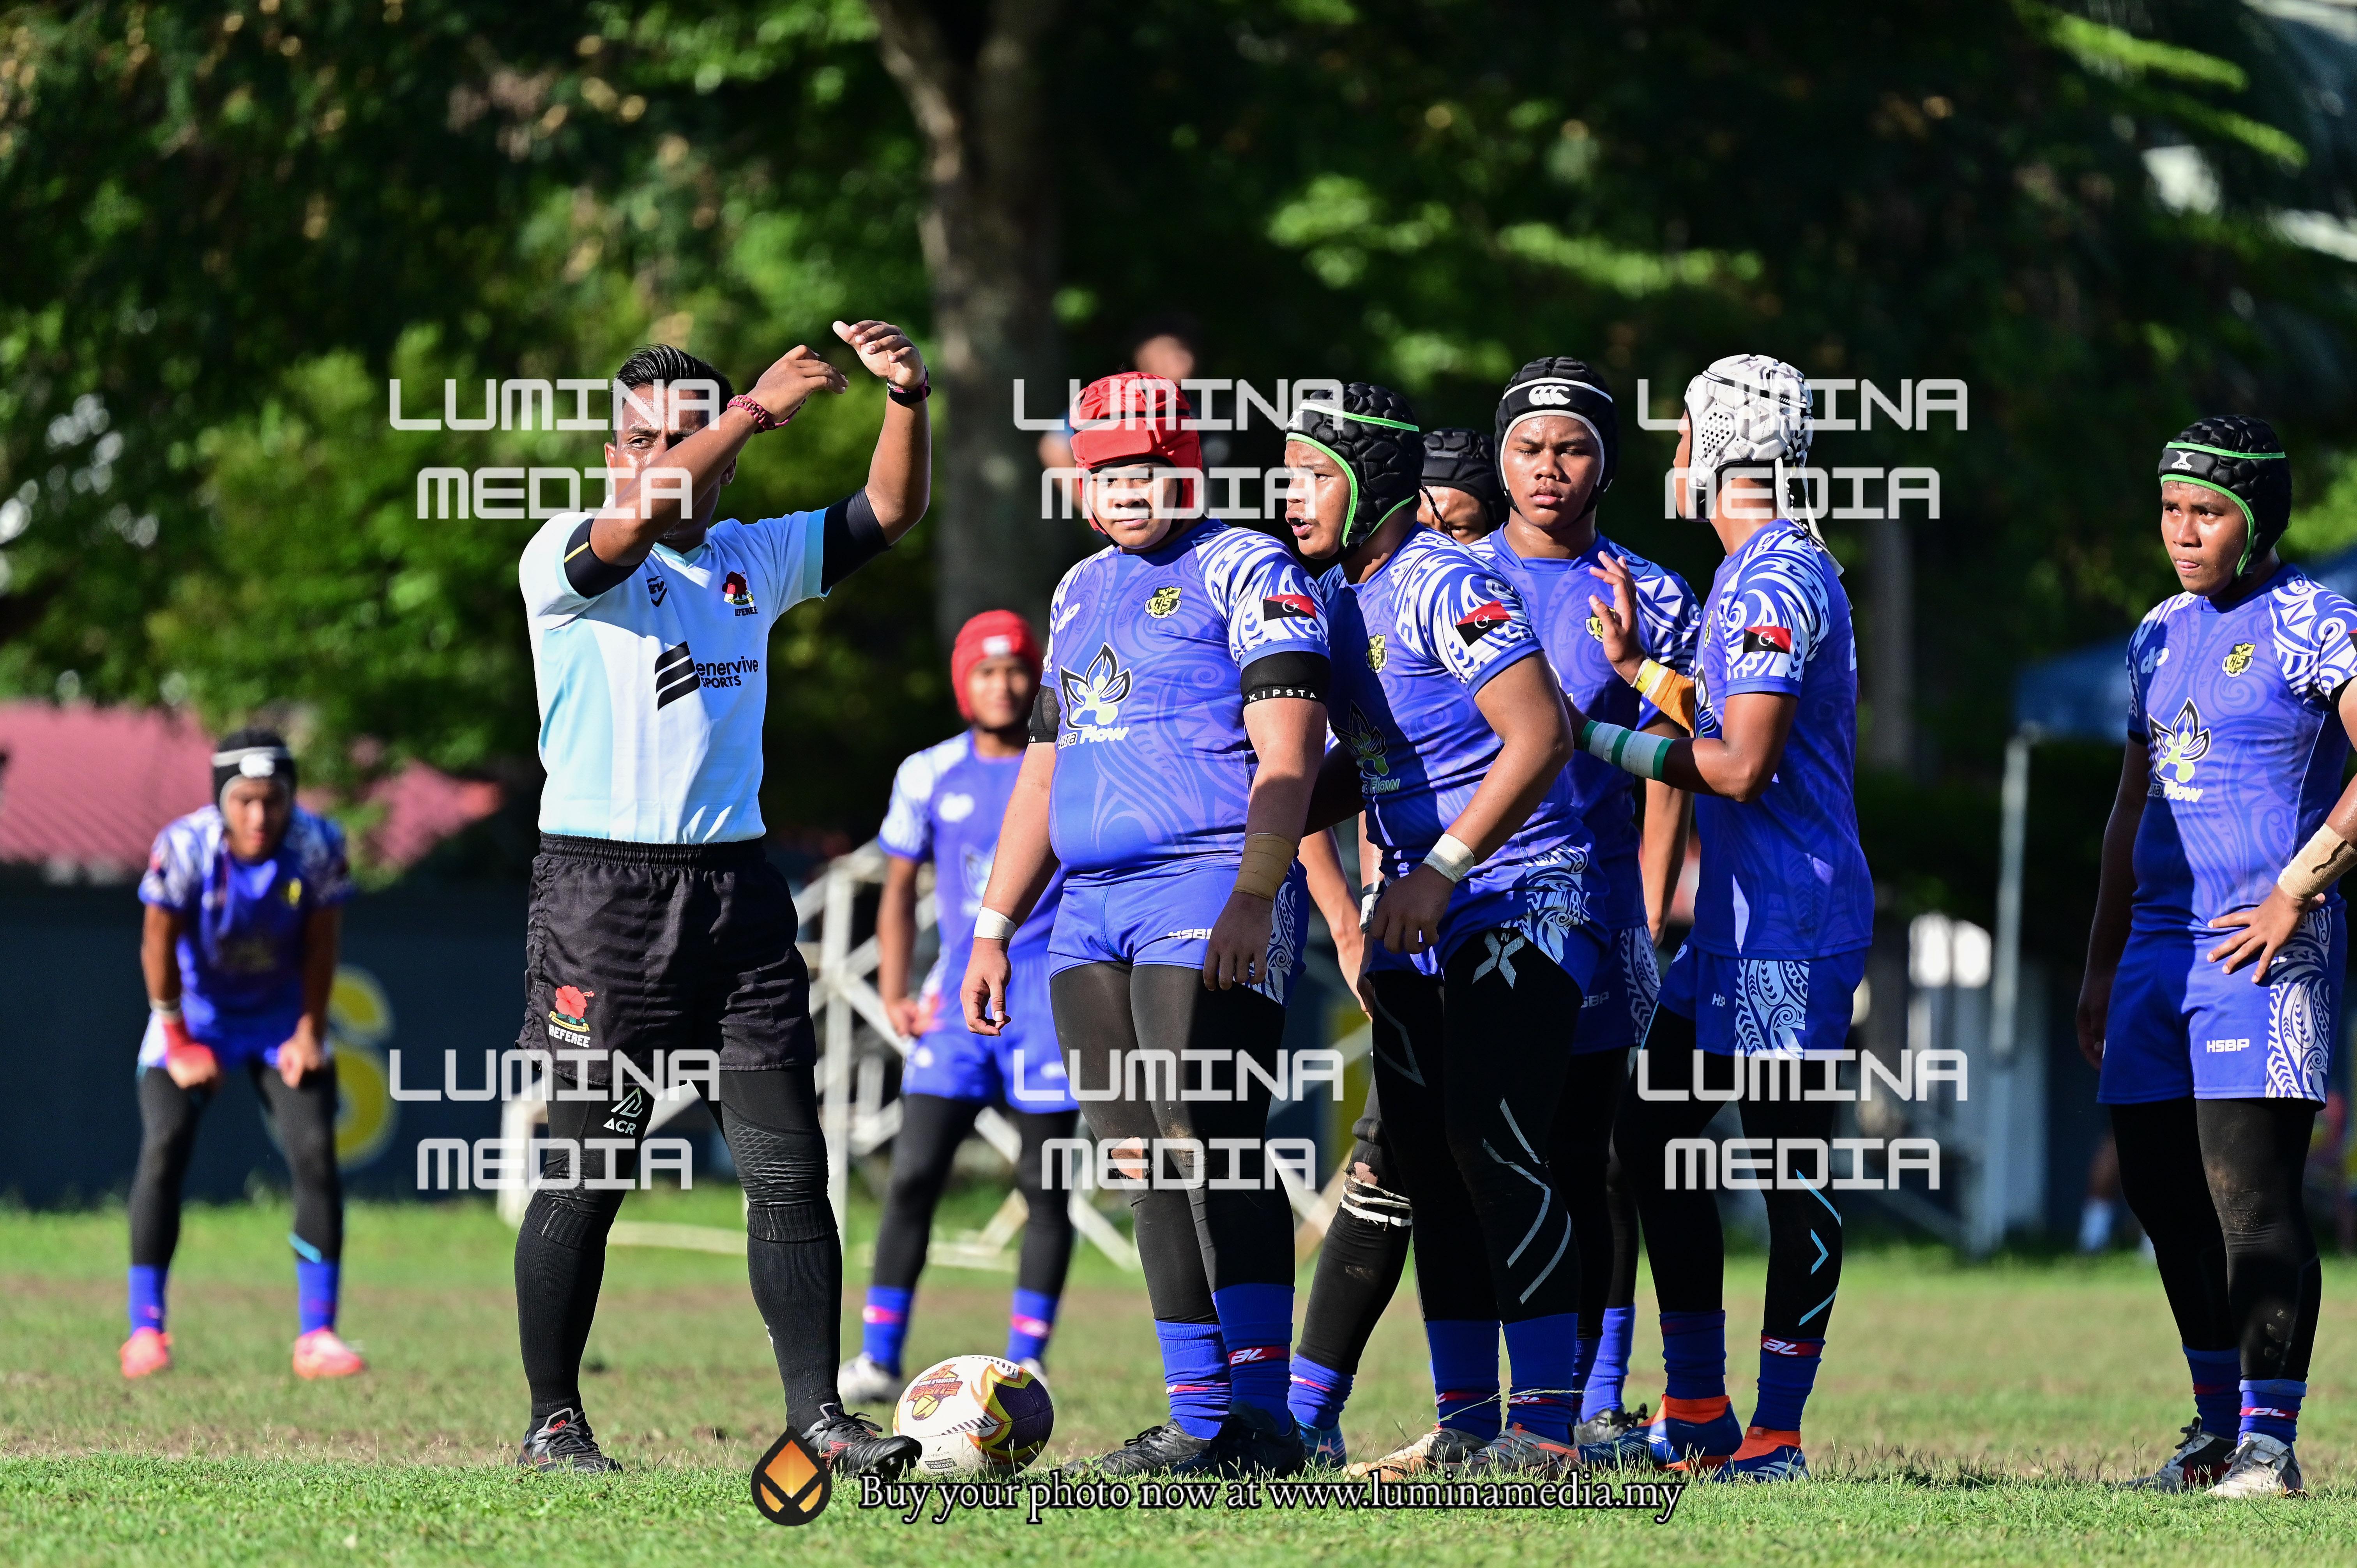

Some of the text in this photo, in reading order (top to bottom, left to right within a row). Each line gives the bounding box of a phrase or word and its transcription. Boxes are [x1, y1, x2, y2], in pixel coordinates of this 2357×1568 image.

[696, 656, 759, 676] enervive
[701, 675, 742, 688] SPORTS
[1249, 689, 1316, 702] KIPSTA
[1079, 725, 1129, 744] Flow
[1370, 777, 1400, 794] Flow
[2163, 781, 2204, 803] Flow
[1581, 991, 1609, 1008] SBP
[548, 1024, 591, 1048] REFEREE
[2206, 1038, 2250, 1053] HSBP
